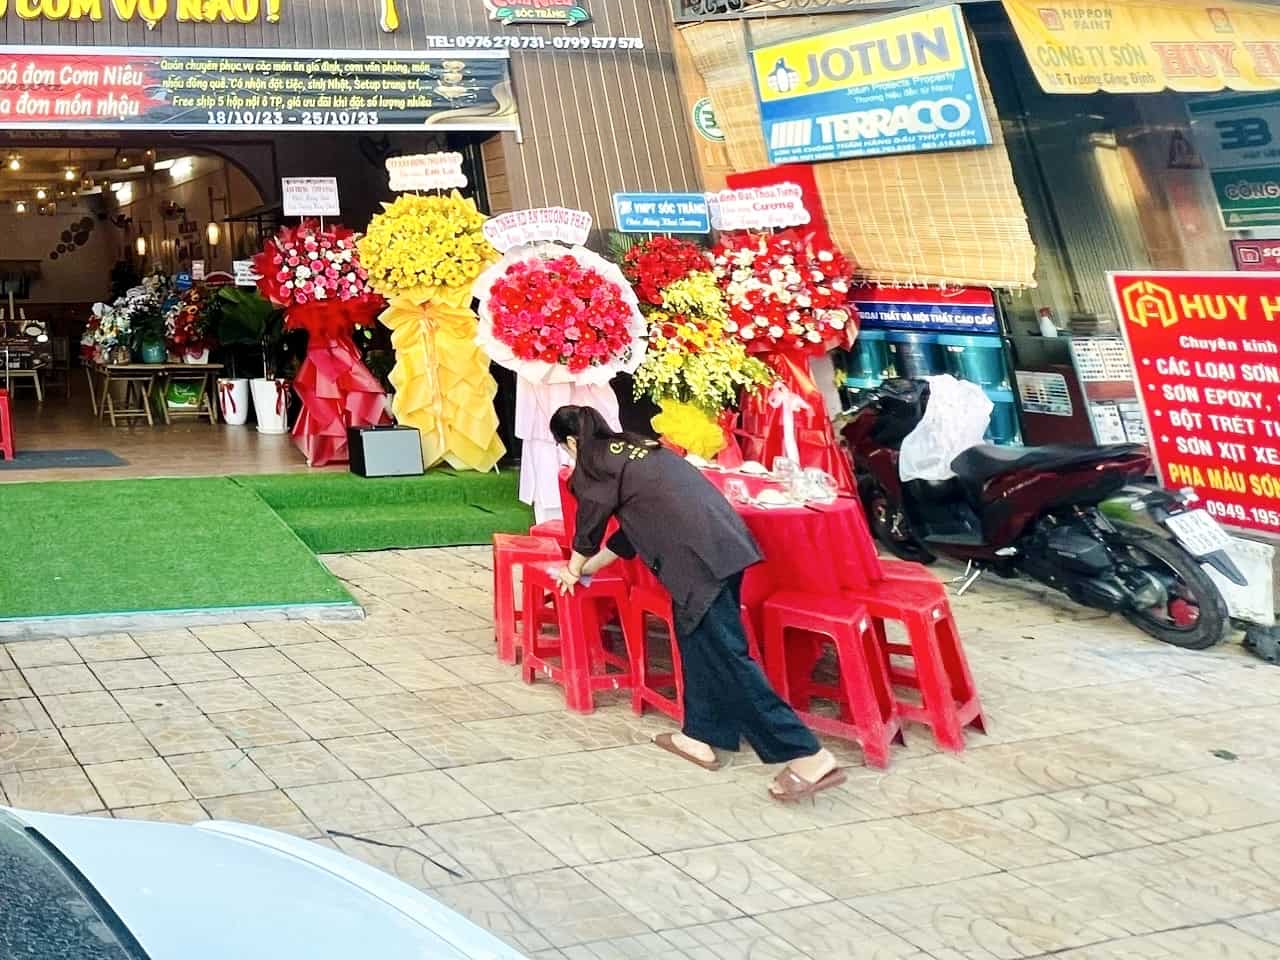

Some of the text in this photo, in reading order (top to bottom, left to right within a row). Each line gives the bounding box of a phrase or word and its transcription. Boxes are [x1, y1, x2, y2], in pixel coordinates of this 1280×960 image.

[426, 35, 456, 48] TEL:
[804, 25, 952, 88] JOTUN
[1036, 42, 1086, 68] CÔNG
[1087, 44, 1108, 67] TY
[1150, 41, 1240, 79] HUY
[21, 64, 57, 85] đơn
[102, 65, 144, 86] Niêu
[15, 93, 51, 116] đơn
[54, 93, 92, 116] món
[96, 93, 141, 121] nhậu
[172, 96, 194, 107] Free
[195, 94, 216, 110] ship
[207, 111, 380, 126] 18/10/23 25/10/23
[815, 96, 971, 144] TERRACO
[1179, 294, 1249, 321] HUY
[1178, 335, 1278, 354] Chuyên kinh
[1155, 356, 1191, 377] CÁC
[1195, 360, 1236, 384] LOẠI
[1161, 383, 1200, 404] SƠN
[1168, 408, 1257, 436] BỘT TRÉT
[1175, 434, 1214, 458] SƠN
[1217, 441, 1247, 464] XỊT
[1167, 461, 1206, 486] PHA
[1207, 465, 1248, 495] MÀU
